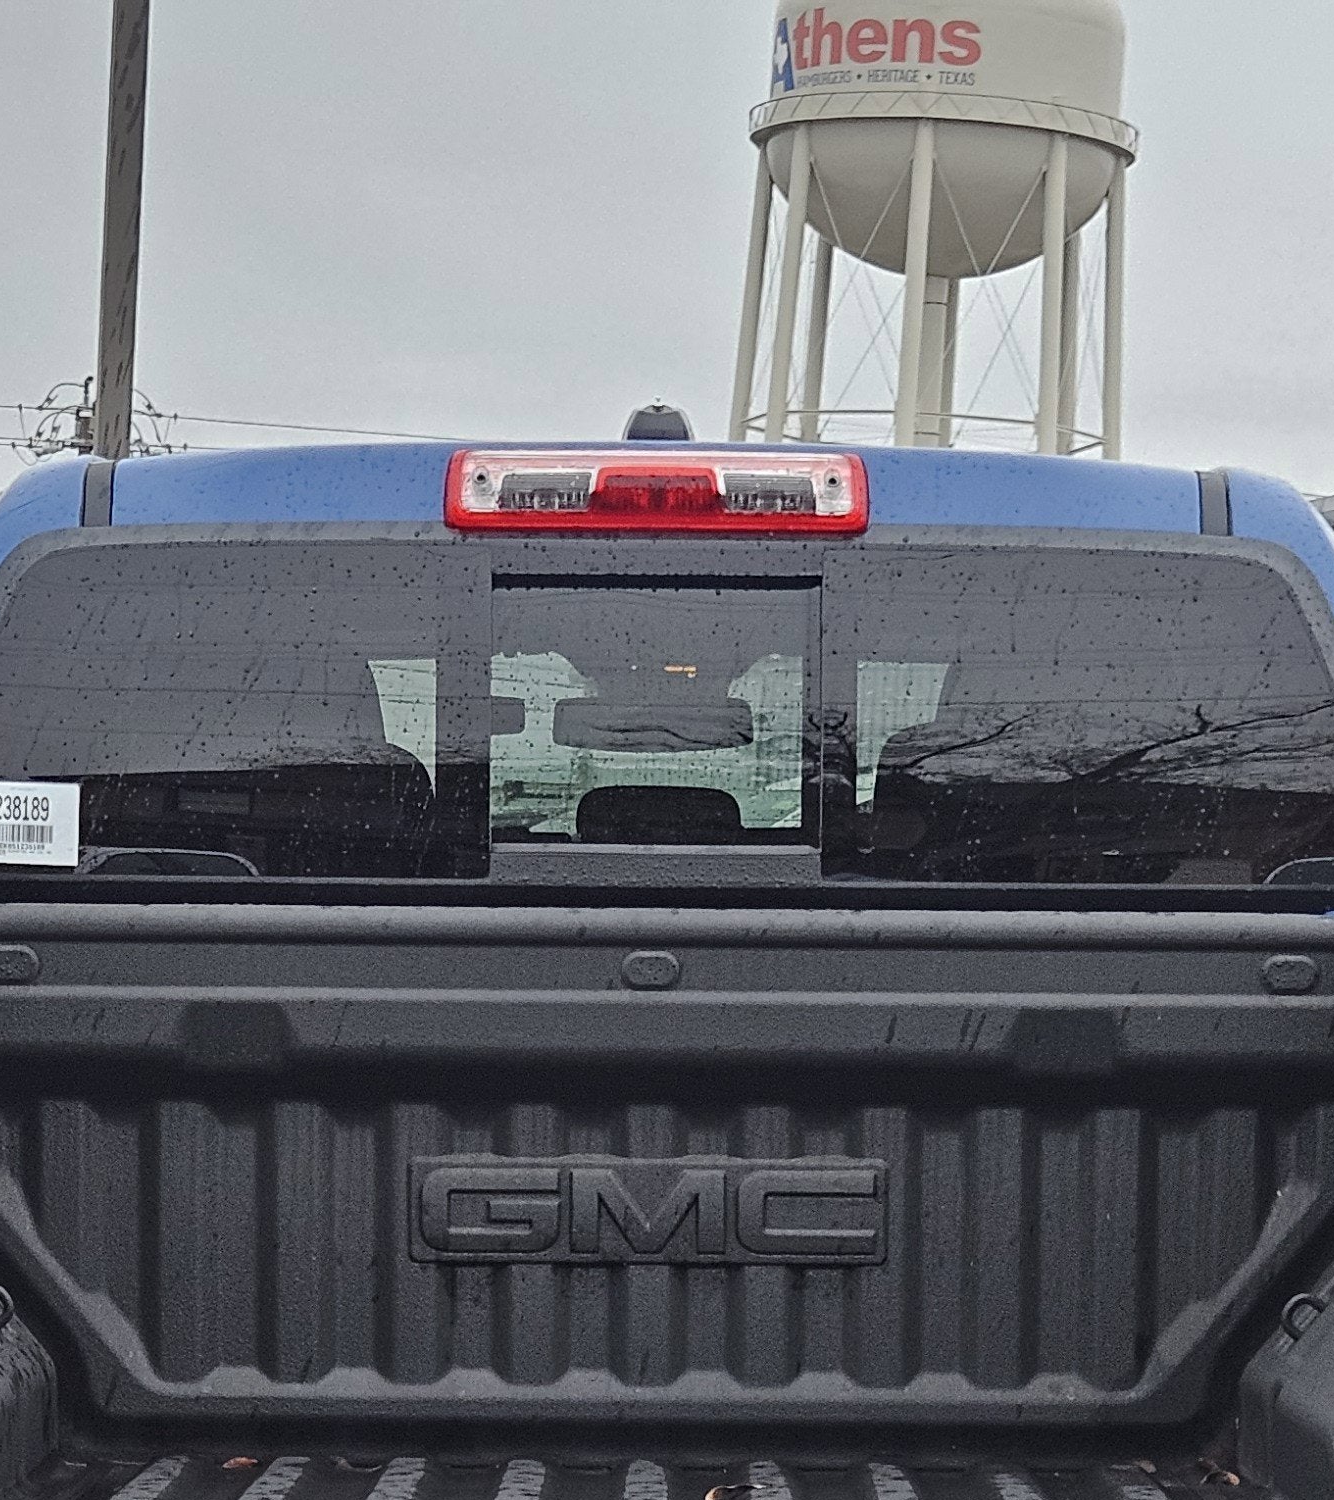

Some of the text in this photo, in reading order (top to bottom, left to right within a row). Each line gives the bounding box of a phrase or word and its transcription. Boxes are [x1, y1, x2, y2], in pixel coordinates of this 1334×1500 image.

[770, 7, 982, 98] Athens
[867, 69, 919, 84] HERITAGE
[939, 71, 976, 86] TEXAS
[419, 1168, 880, 1256] GMC
